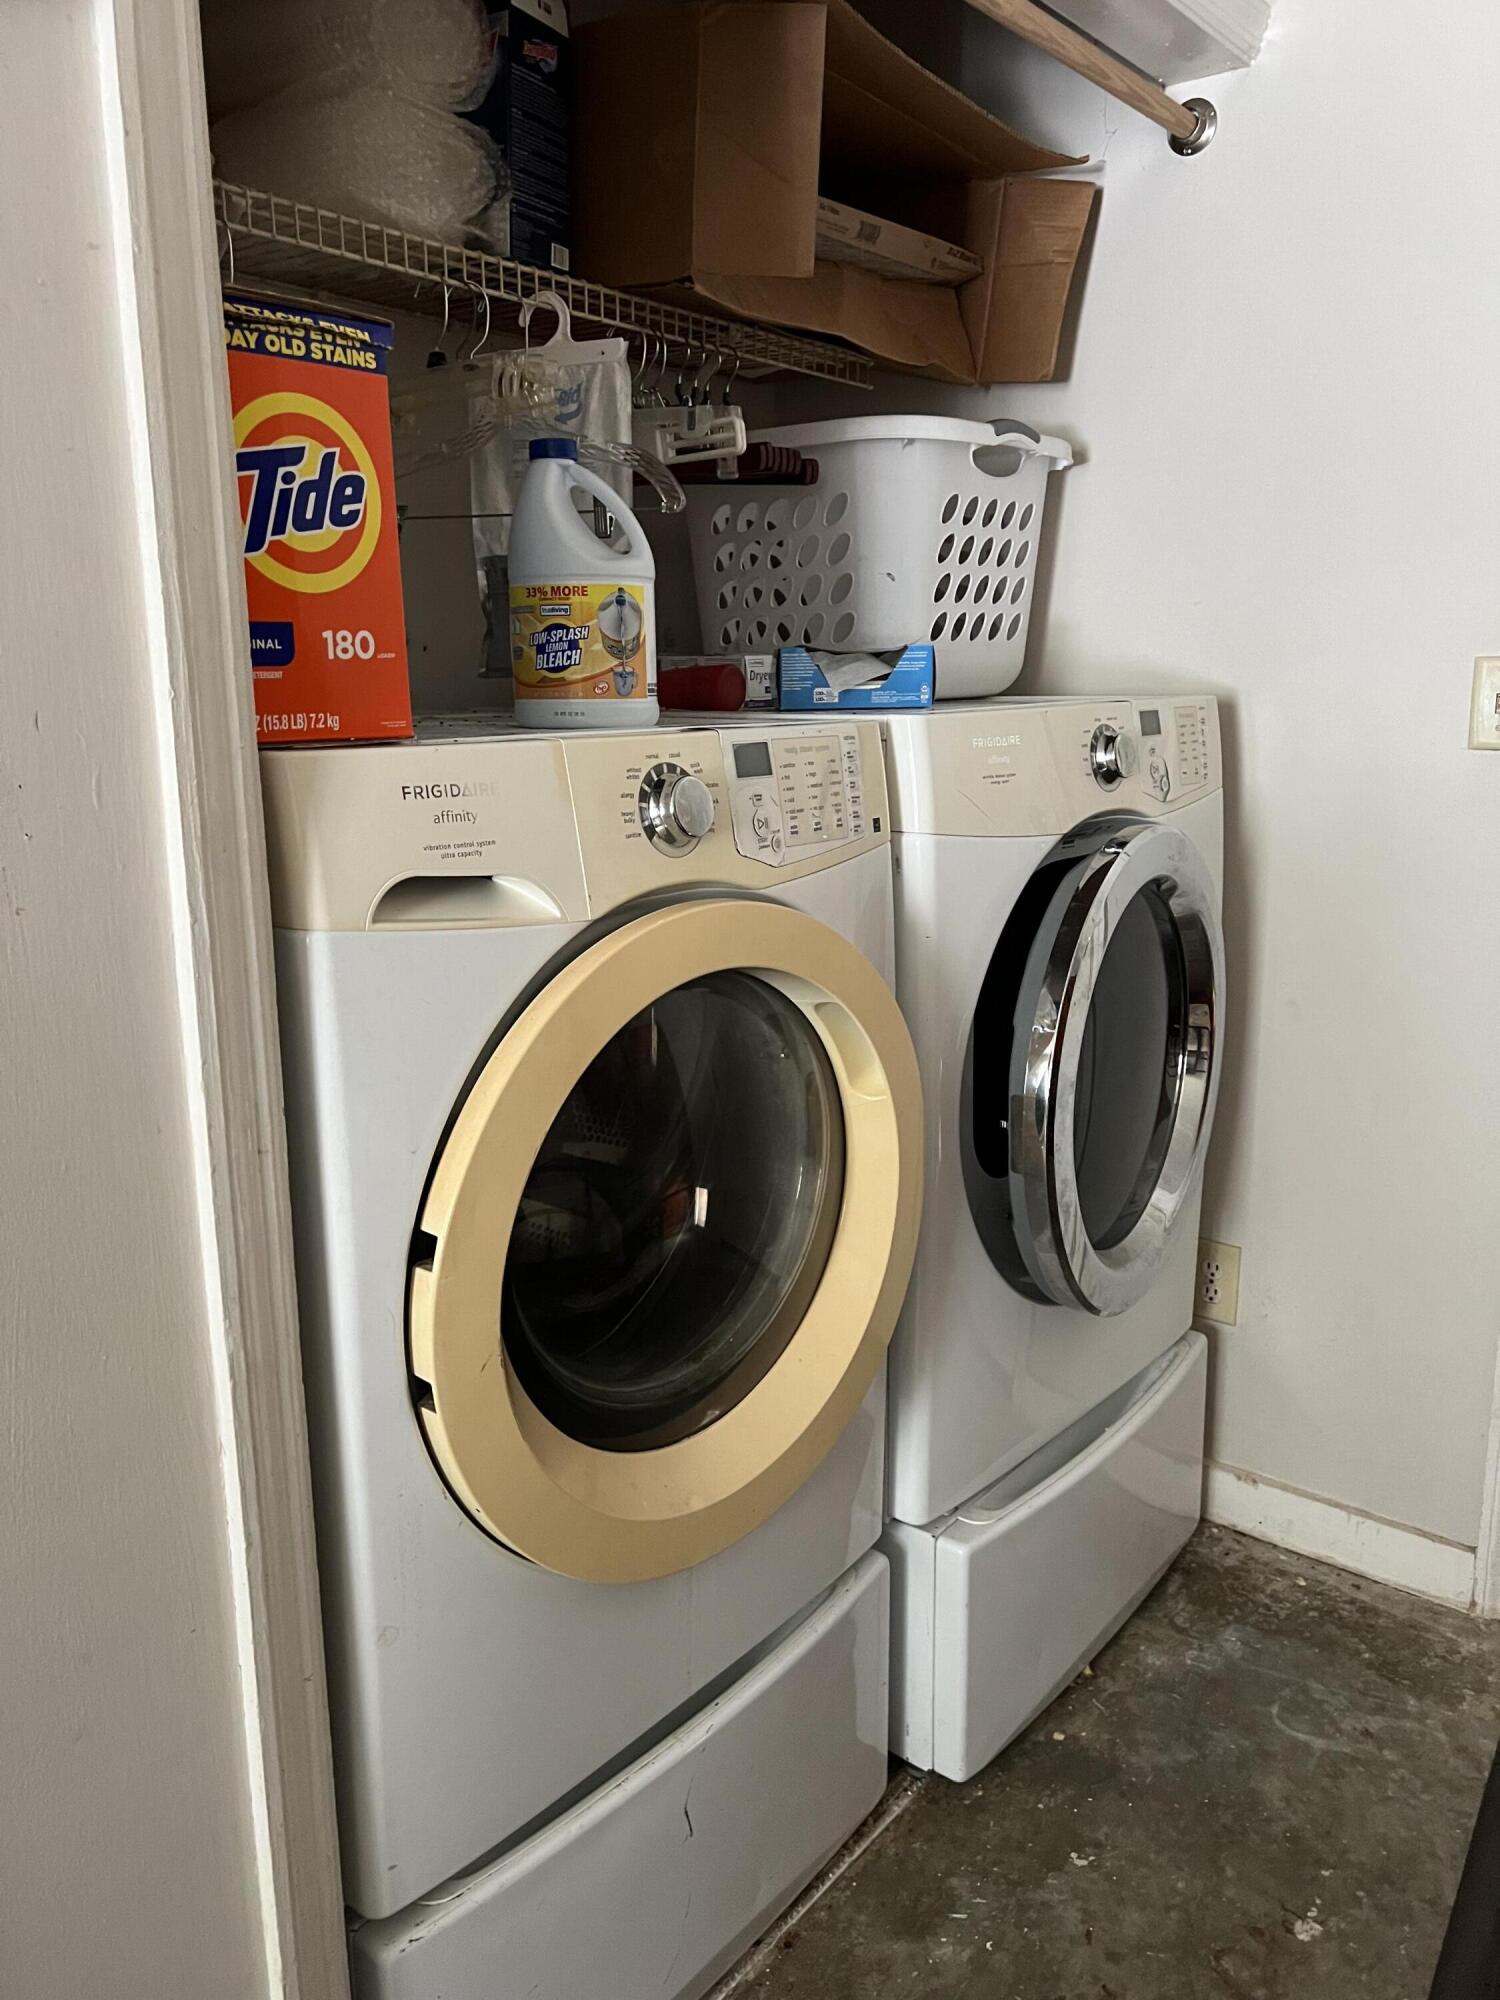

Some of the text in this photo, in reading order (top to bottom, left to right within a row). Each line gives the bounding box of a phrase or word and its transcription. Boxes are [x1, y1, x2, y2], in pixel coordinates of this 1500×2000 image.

[264, 335, 306, 357] OLD
[311, 342, 377, 370] STAINS
[236, 446, 366, 554] Tide
[525, 586, 589, 598] 33% MORE
[250, 638, 283, 649] INAL
[530, 626, 589, 646] LOW-SPLASH
[322, 630, 375, 660] 180
[545, 641, 569, 652] LEMON
[536, 649, 581, 669] BLEACH
[263, 713, 288, 733] (15.8
[291, 713, 308, 731] LB)
[309, 713, 325, 729] 7.2
[327, 713, 340, 731] kg
[972, 735, 1021, 749] FRIGIDAIRE
[433, 810, 478, 825] affinity
[453, 841, 475, 849] control
[476, 839, 497, 848] system
[440, 850, 483, 859] ultra capacity
